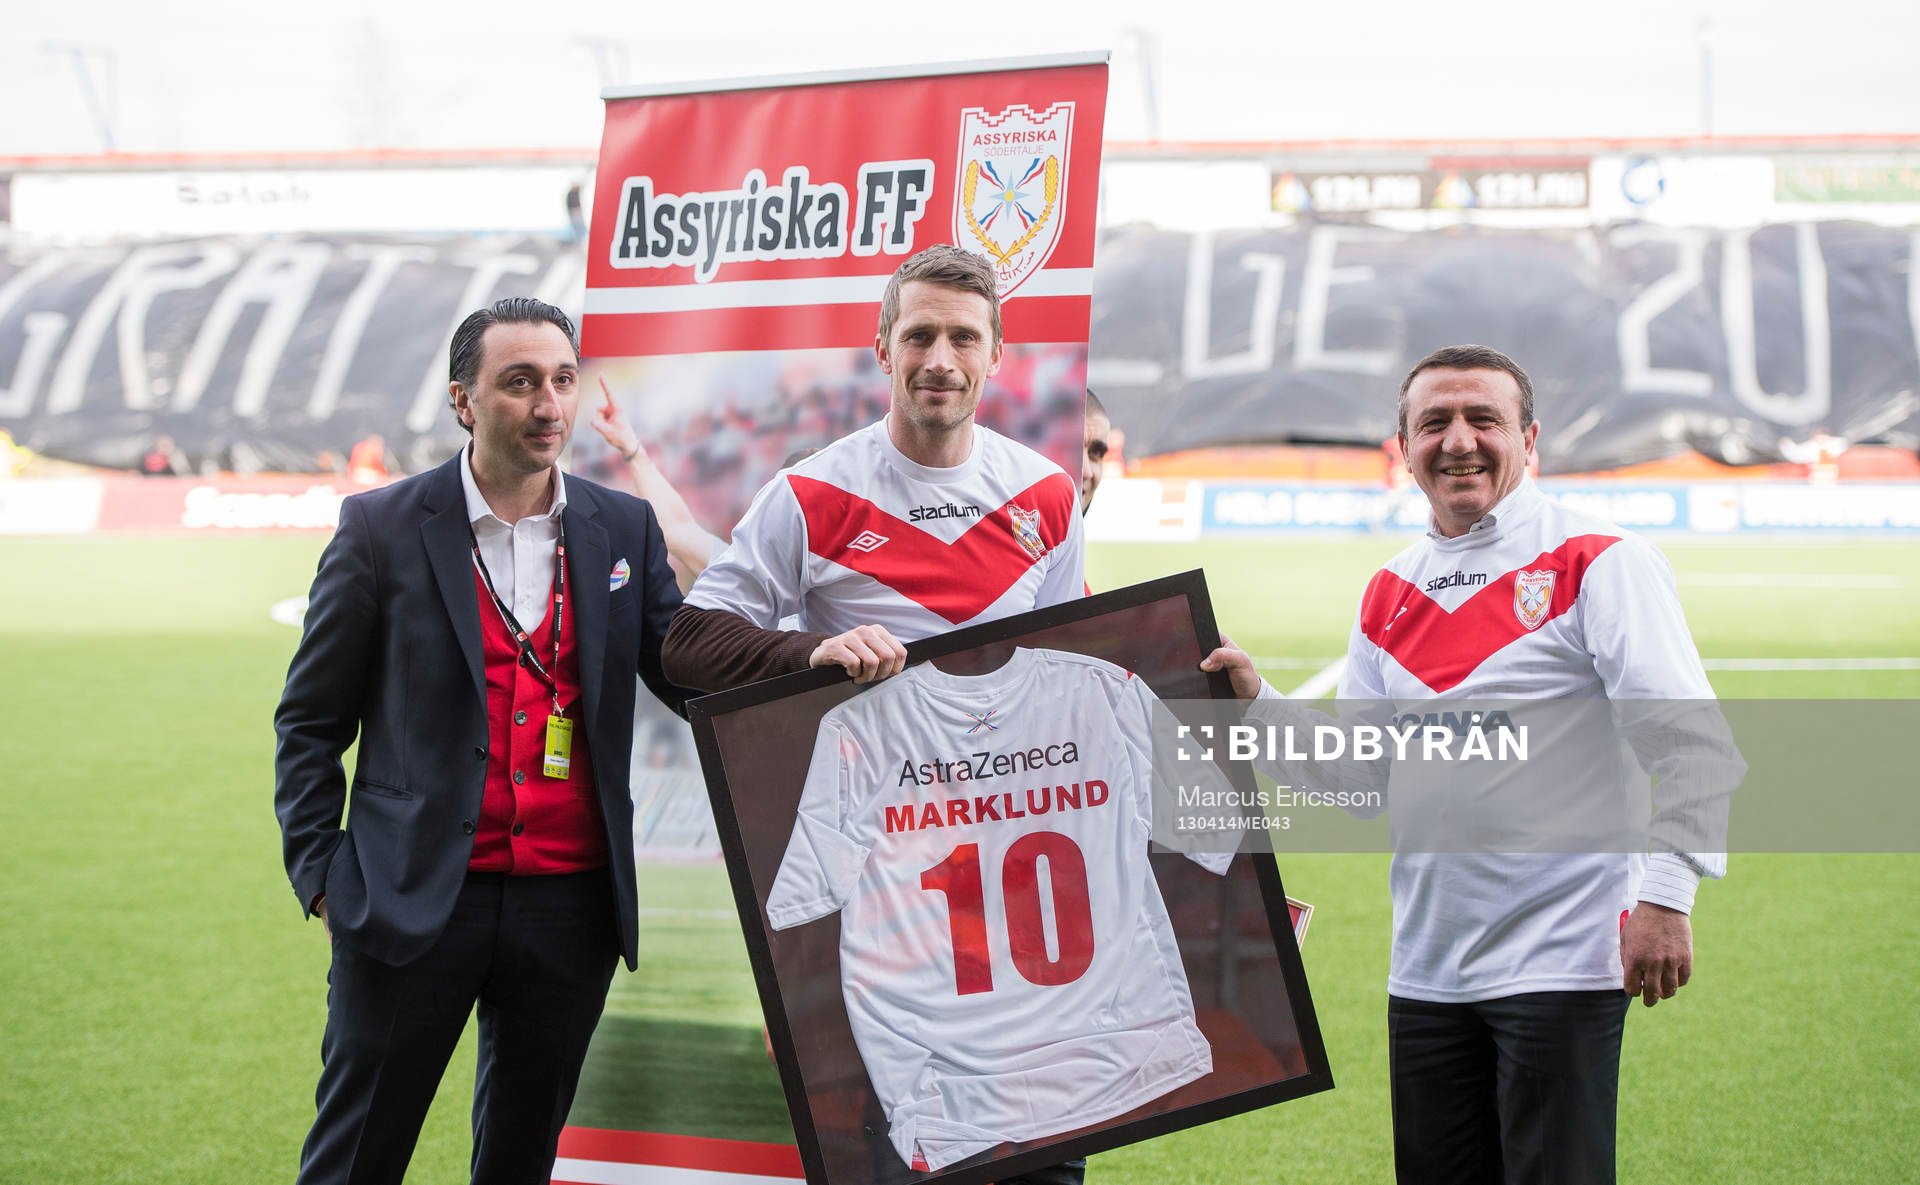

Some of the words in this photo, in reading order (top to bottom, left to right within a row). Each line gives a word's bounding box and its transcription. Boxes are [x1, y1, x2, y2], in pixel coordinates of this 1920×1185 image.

[973, 130, 1057, 146] ASSYRISKA
[984, 145, 1045, 157] SÖDERTÄLJE
[618, 178, 839, 275] Assyriska
[860, 168, 926, 247] FF
[909, 502, 981, 522] stadium
[1425, 571, 1487, 591] stadium
[1392, 710, 1516, 739] CANIA
[898, 741, 1079, 787] AstraZeneca
[885, 779, 1110, 833] MARKLUND
[920, 831, 1095, 995] 10
